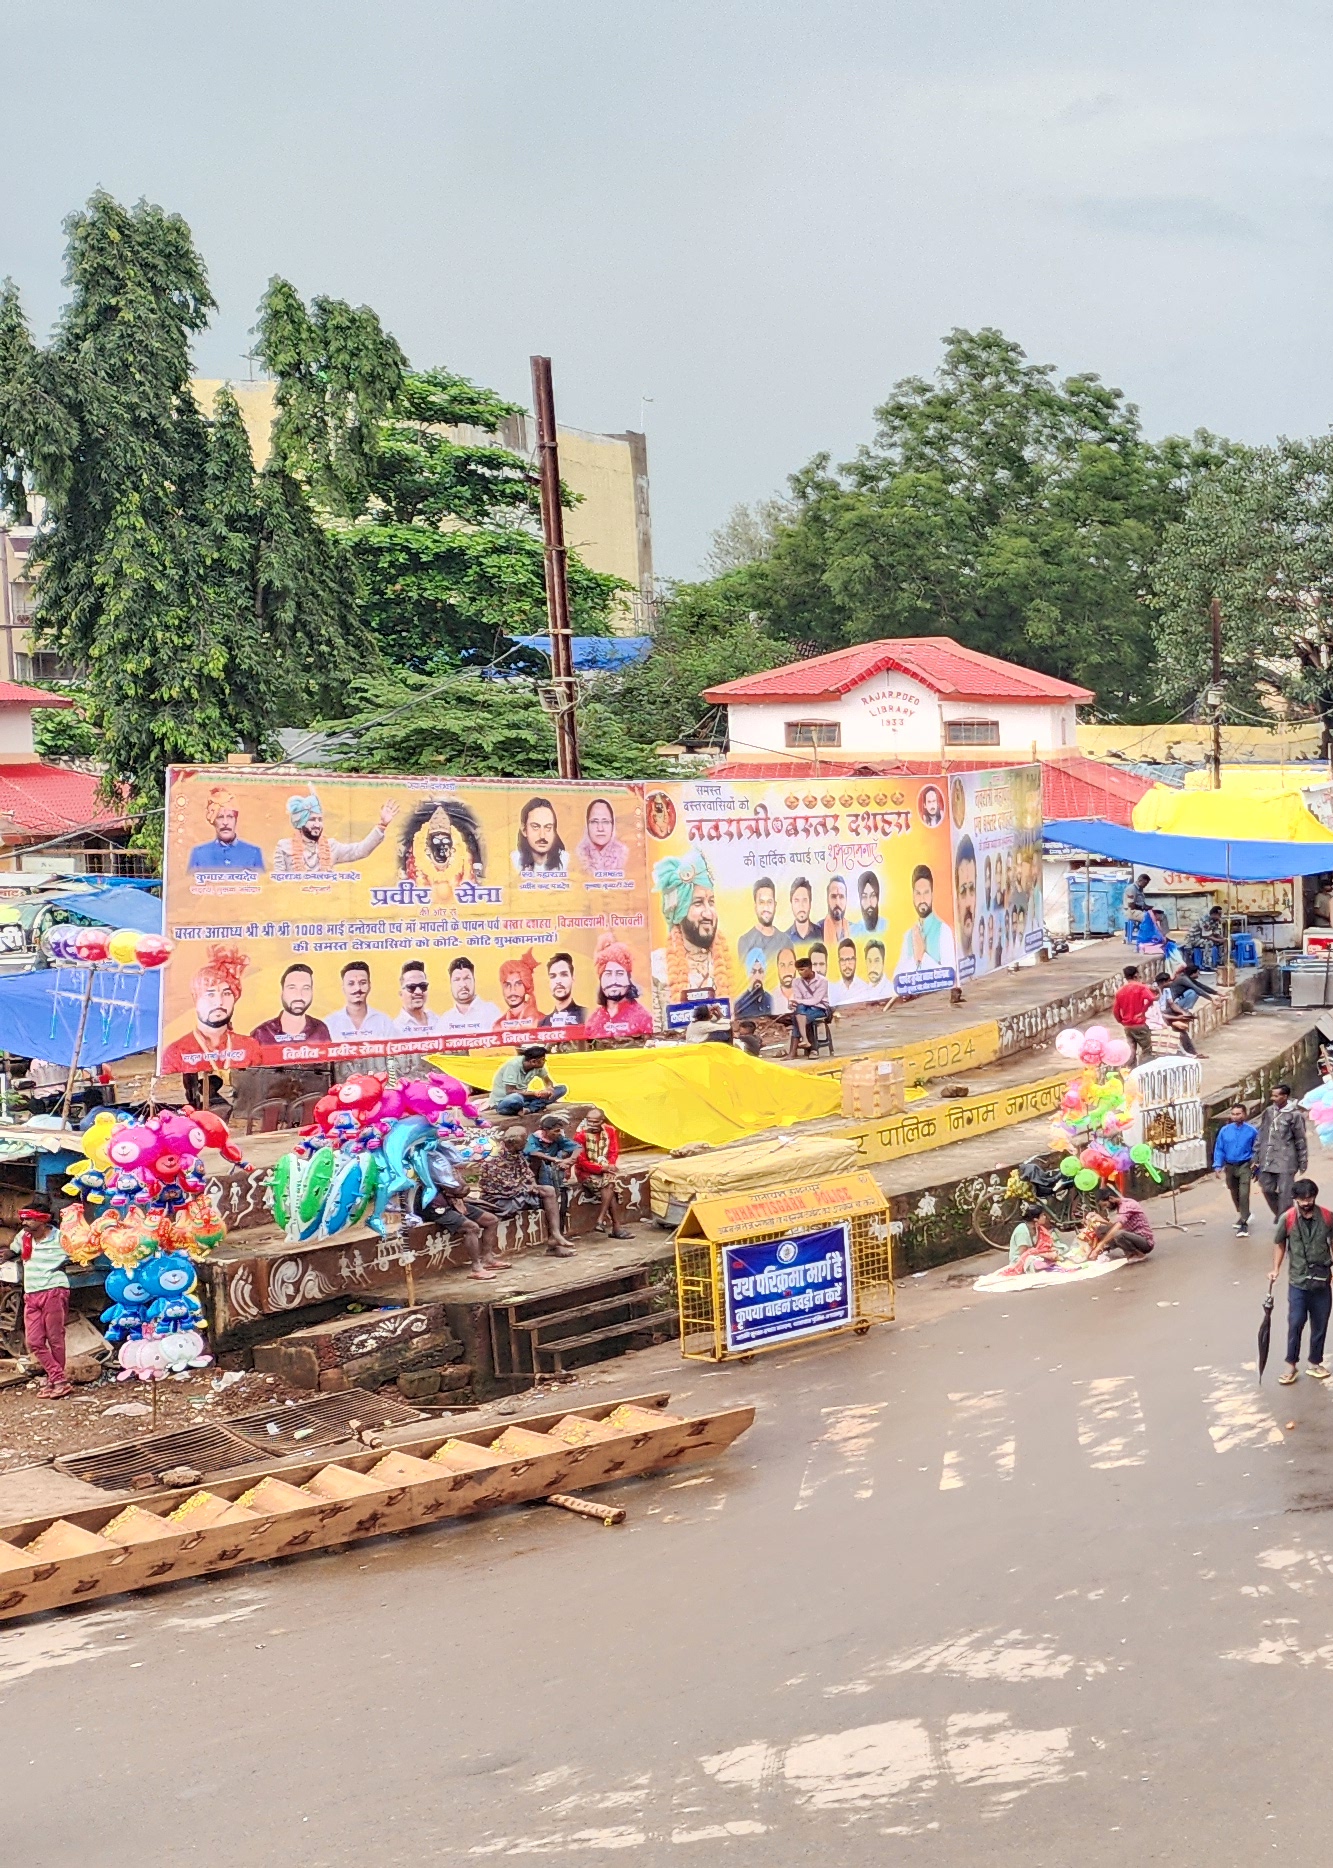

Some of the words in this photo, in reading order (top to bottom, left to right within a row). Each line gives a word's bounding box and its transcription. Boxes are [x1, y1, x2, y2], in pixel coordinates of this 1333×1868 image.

[869, 705, 915, 717] LIBRARY
[695, 784, 722, 796] समस्त
[738, 795, 750, 811] को
[686, 802, 771, 843] नवरात्री
[846, 809, 911, 838] दशहरा
[743, 853, 755, 868] की
[759, 851, 786, 869] हार्दिक
[370, 881, 432, 906] प्रवीर
[455, 881, 502, 904] सेना
[205, 925, 243, 939] आराध्य
[245, 923, 259, 938] श्री
[261, 923, 275, 938] श्री
[277, 922, 290, 937] श्री
[295, 924, 323, 936] 1008
[327, 921, 344, 936] माई
[420, 917, 449, 933] मावली
[450, 917, 459, 932] के
[462, 919, 485, 932] पावन
[292, 940, 311, 952] की
[313, 941, 347, 951] समस्त
[351, 935, 412, 951] क्षेत्रवासियों
[415, 938, 430, 949] को
[466, 934, 491, 947] कोटि
[923, 1038, 976, 1071] 2024
[876, 1115, 937, 1148] पालिक
[945, 1101, 999, 1132] निगम
[1005, 1080, 1068, 1117] जगदलपु
[724, 1194, 806, 1223] CHHATTISGARH
[814, 1186, 853, 1205] POLICE
[731, 1277, 754, 1301] रथ
[754, 1263, 805, 1296] परिक्रमा
[806, 1255, 832, 1284] मार्ग
[832, 1250, 843, 1280] है
[734, 1302, 763, 1331] कृपया
[765, 1294, 791, 1317] वाहन
[814, 1292, 824, 1305] न
[825, 1281, 843, 1304] करें
